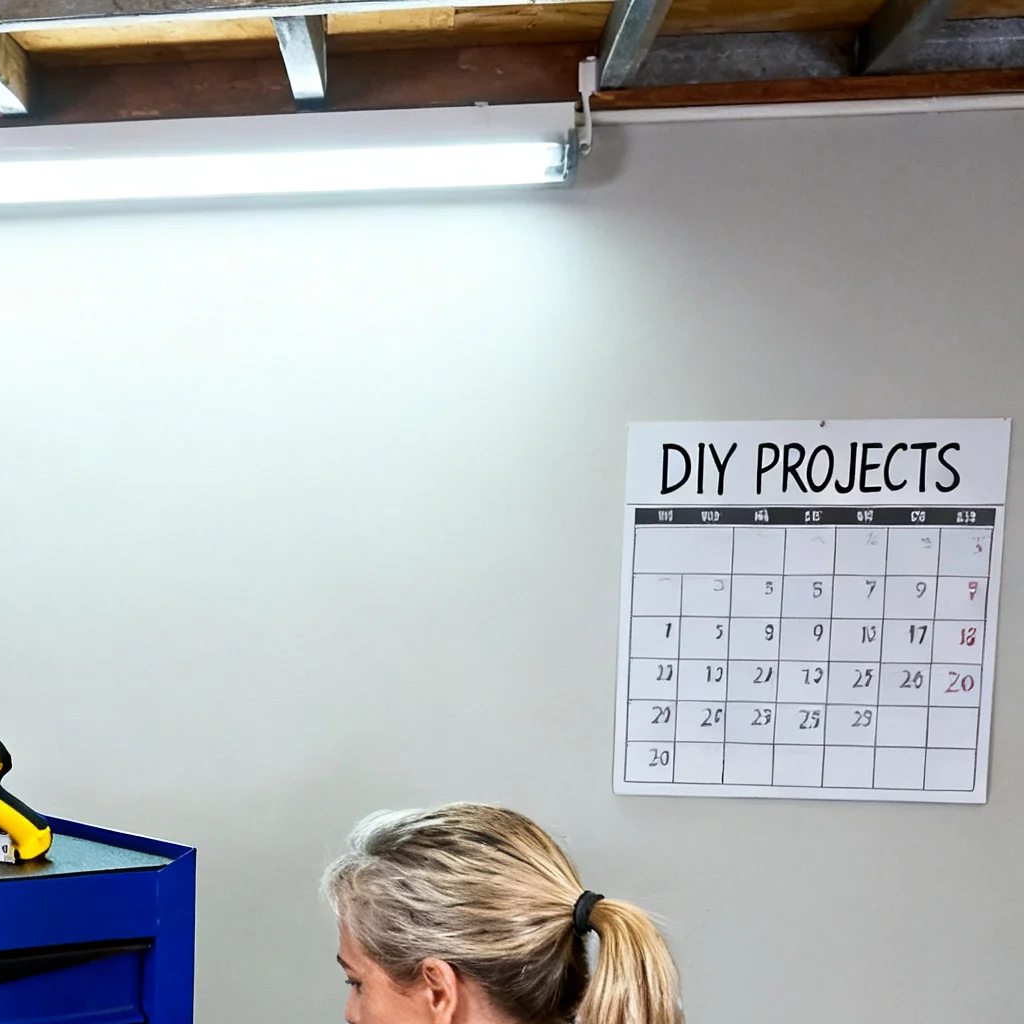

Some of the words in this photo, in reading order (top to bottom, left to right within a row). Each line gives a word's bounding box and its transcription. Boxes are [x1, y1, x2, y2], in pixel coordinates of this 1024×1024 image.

[660, 442, 737, 496] DIY
[756, 442, 961, 495] PROJECTS
[916, 582, 926, 599] 9
[813, 624, 824, 641] 9
[909, 624, 927, 645] 17
[944, 671, 975, 694] 20
